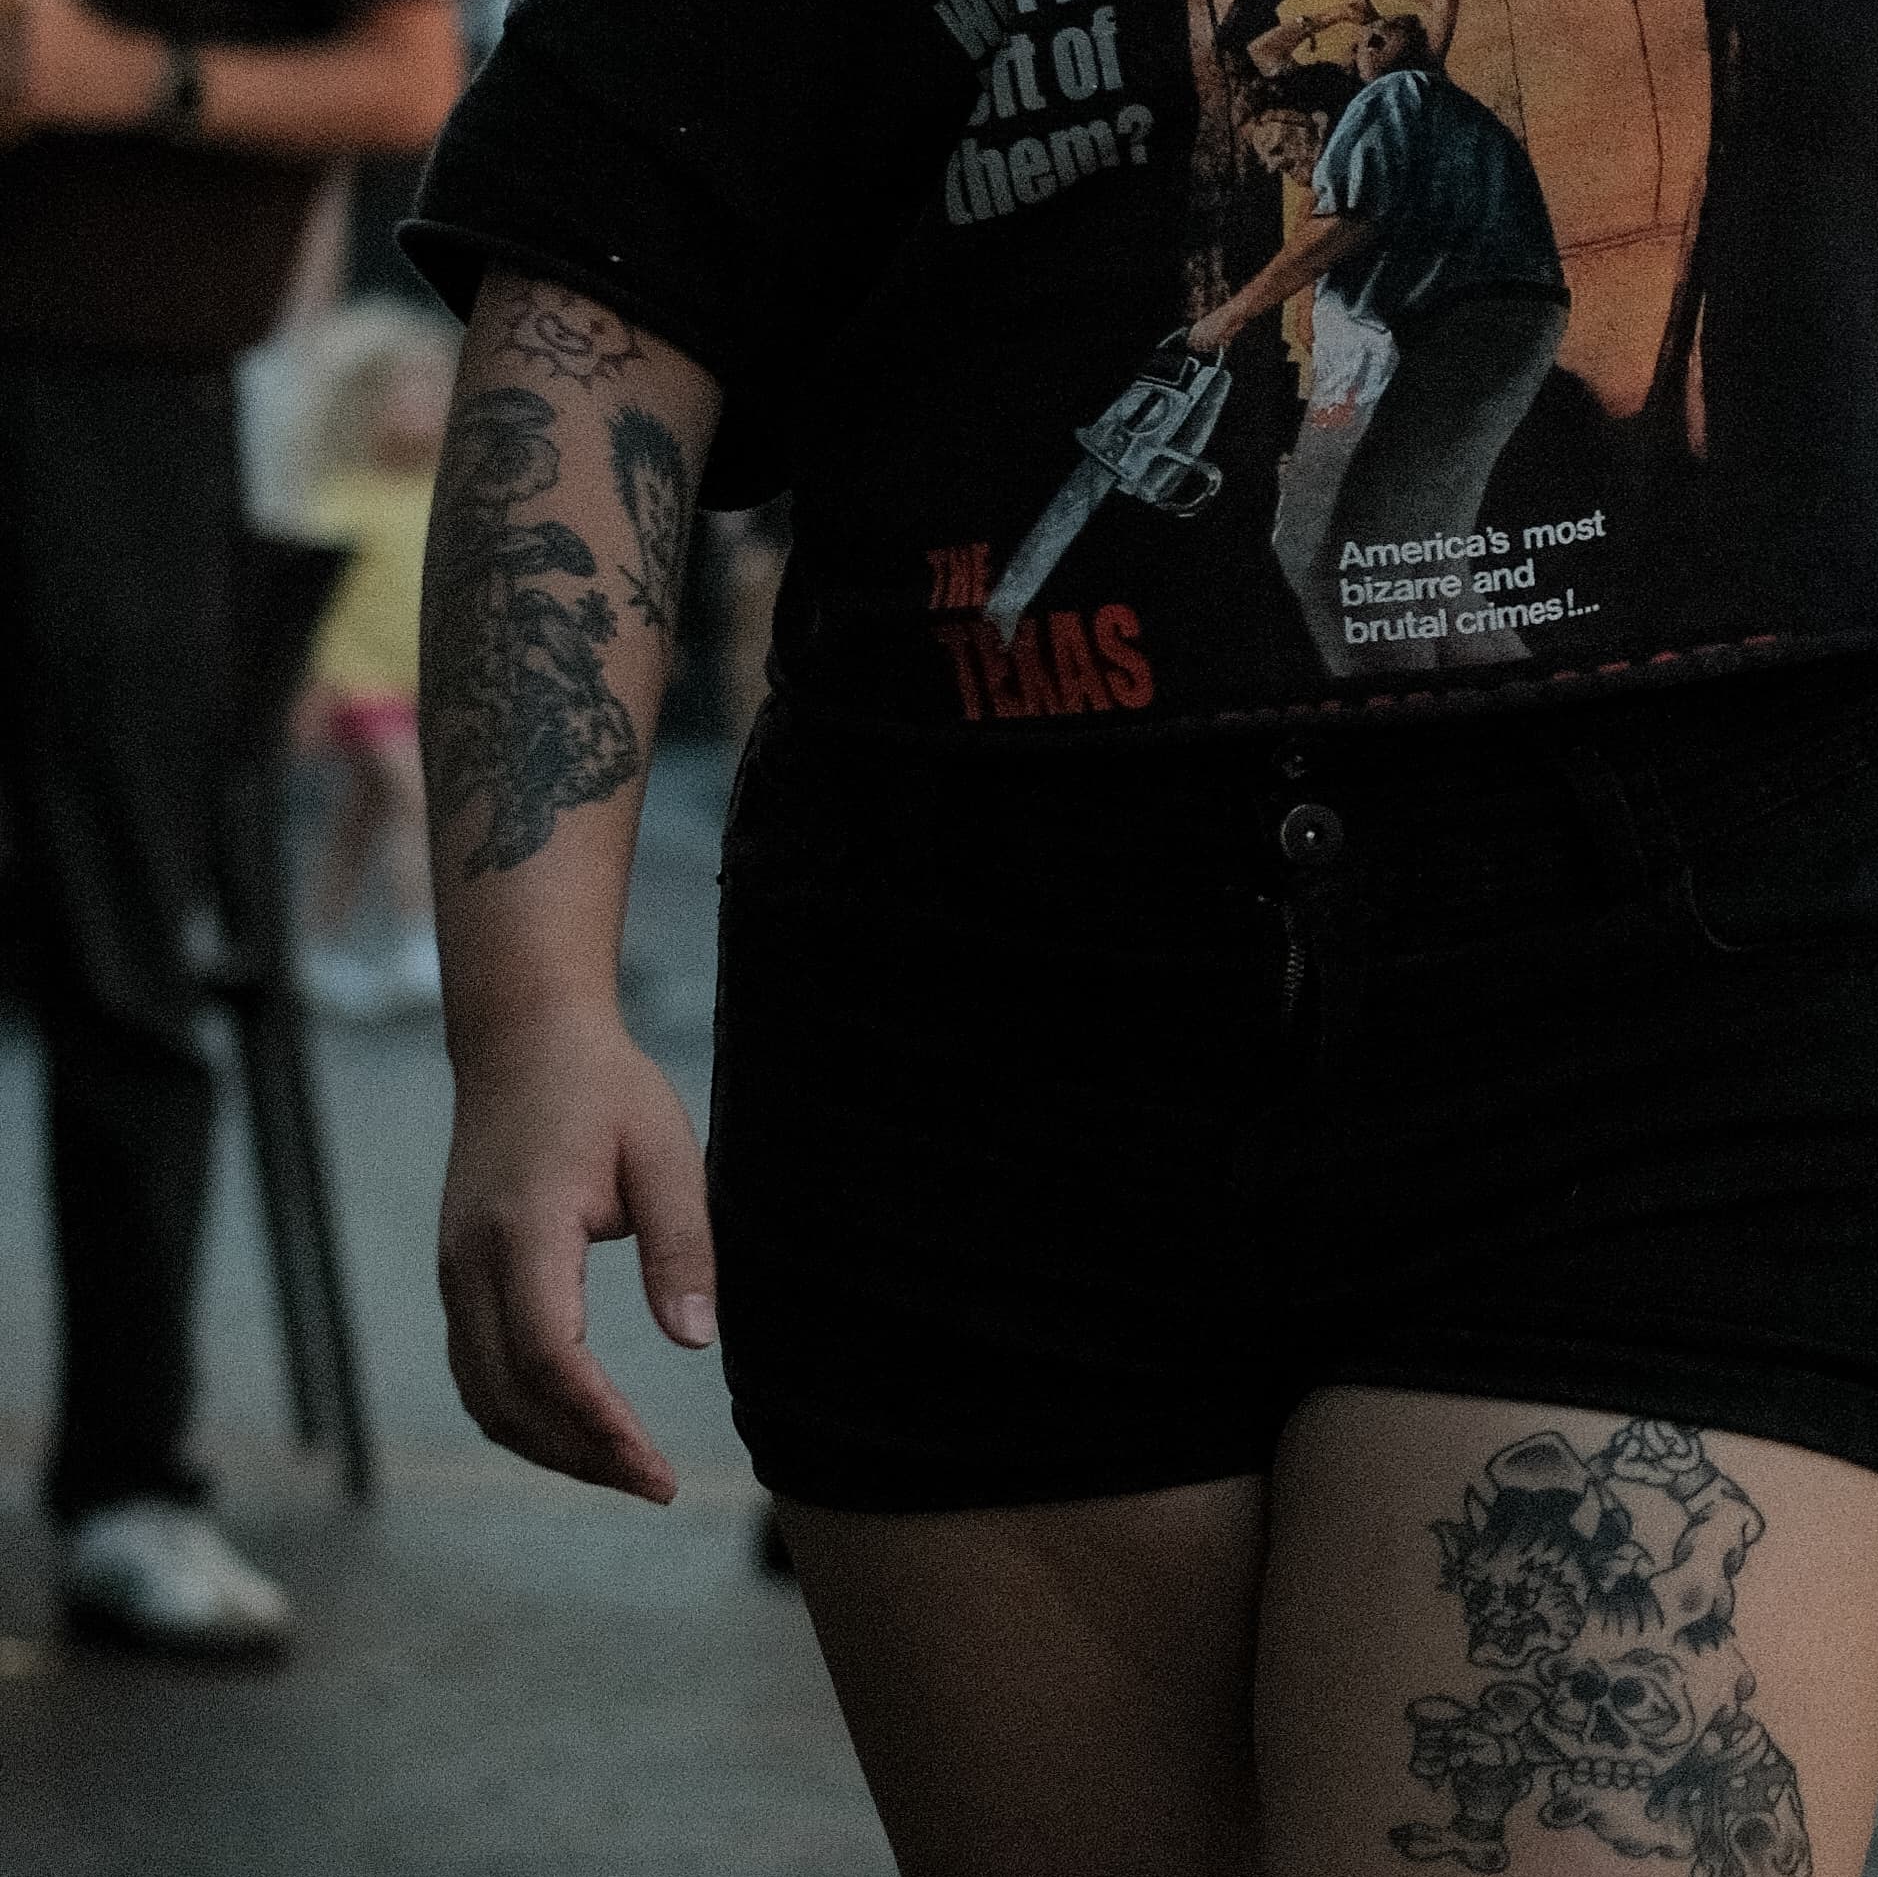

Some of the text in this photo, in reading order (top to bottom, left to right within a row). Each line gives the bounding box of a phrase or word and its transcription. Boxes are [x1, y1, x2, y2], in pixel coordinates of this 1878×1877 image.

[1052, 5, 1125, 102] of
[1339, 509, 1607, 571] America's most
[926, 538, 993, 610] THE
[1339, 558, 1536, 607] bizarre and
[1344, 608, 1448, 644] brutal
